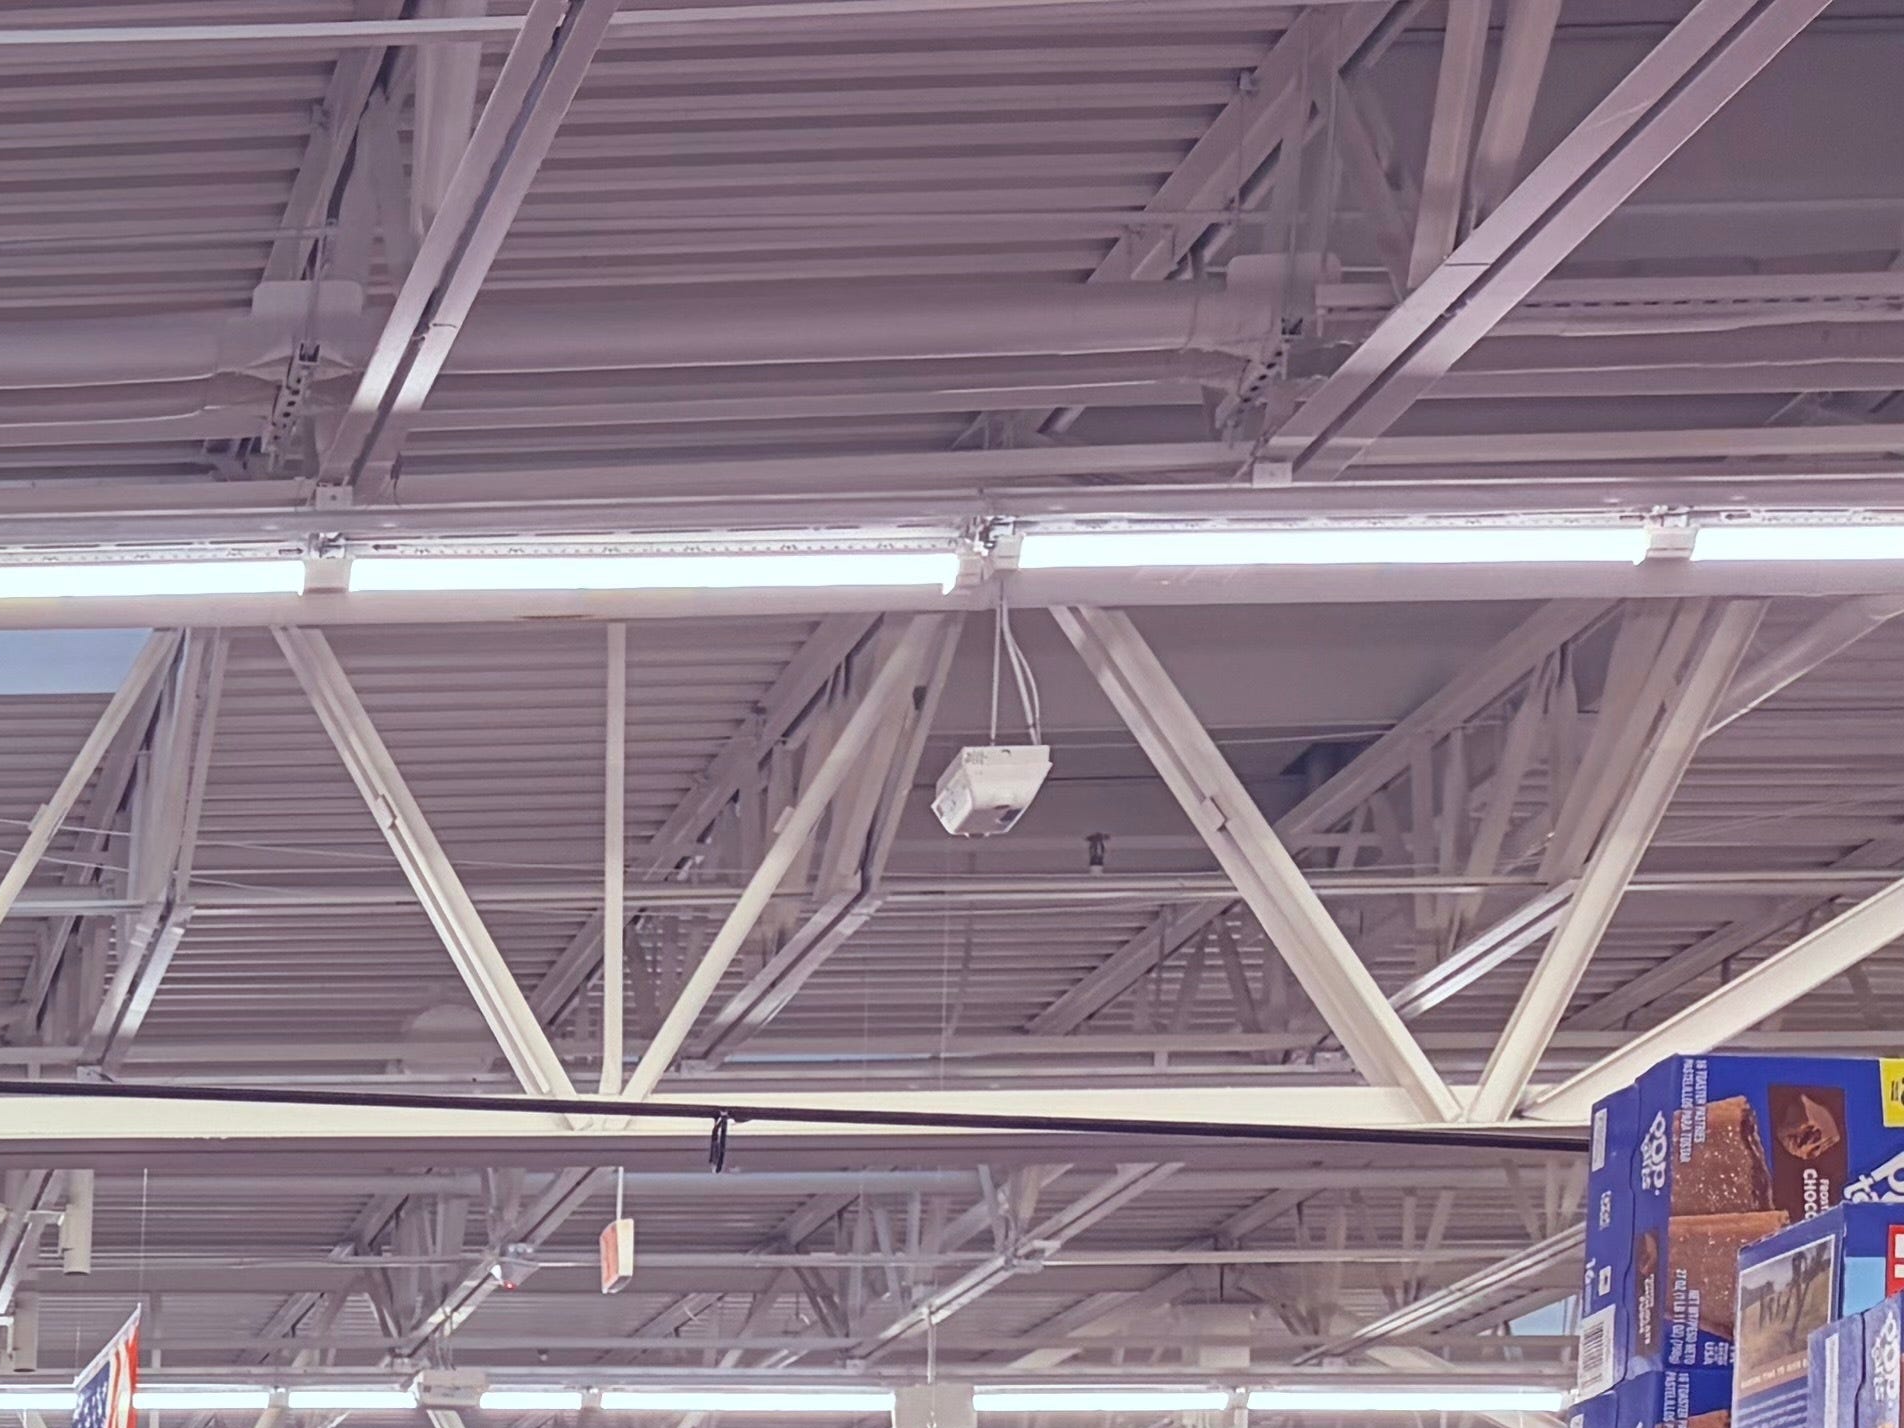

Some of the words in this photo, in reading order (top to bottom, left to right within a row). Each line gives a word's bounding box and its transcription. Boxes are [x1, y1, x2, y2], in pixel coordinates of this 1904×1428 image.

[1697, 1073, 1707, 1106] TOASTER
[1682, 1107, 1690, 1129] PARA
[1694, 1107, 1706, 1144] PASTRIES
[1680, 1131, 1688, 1163] TOSTAR
